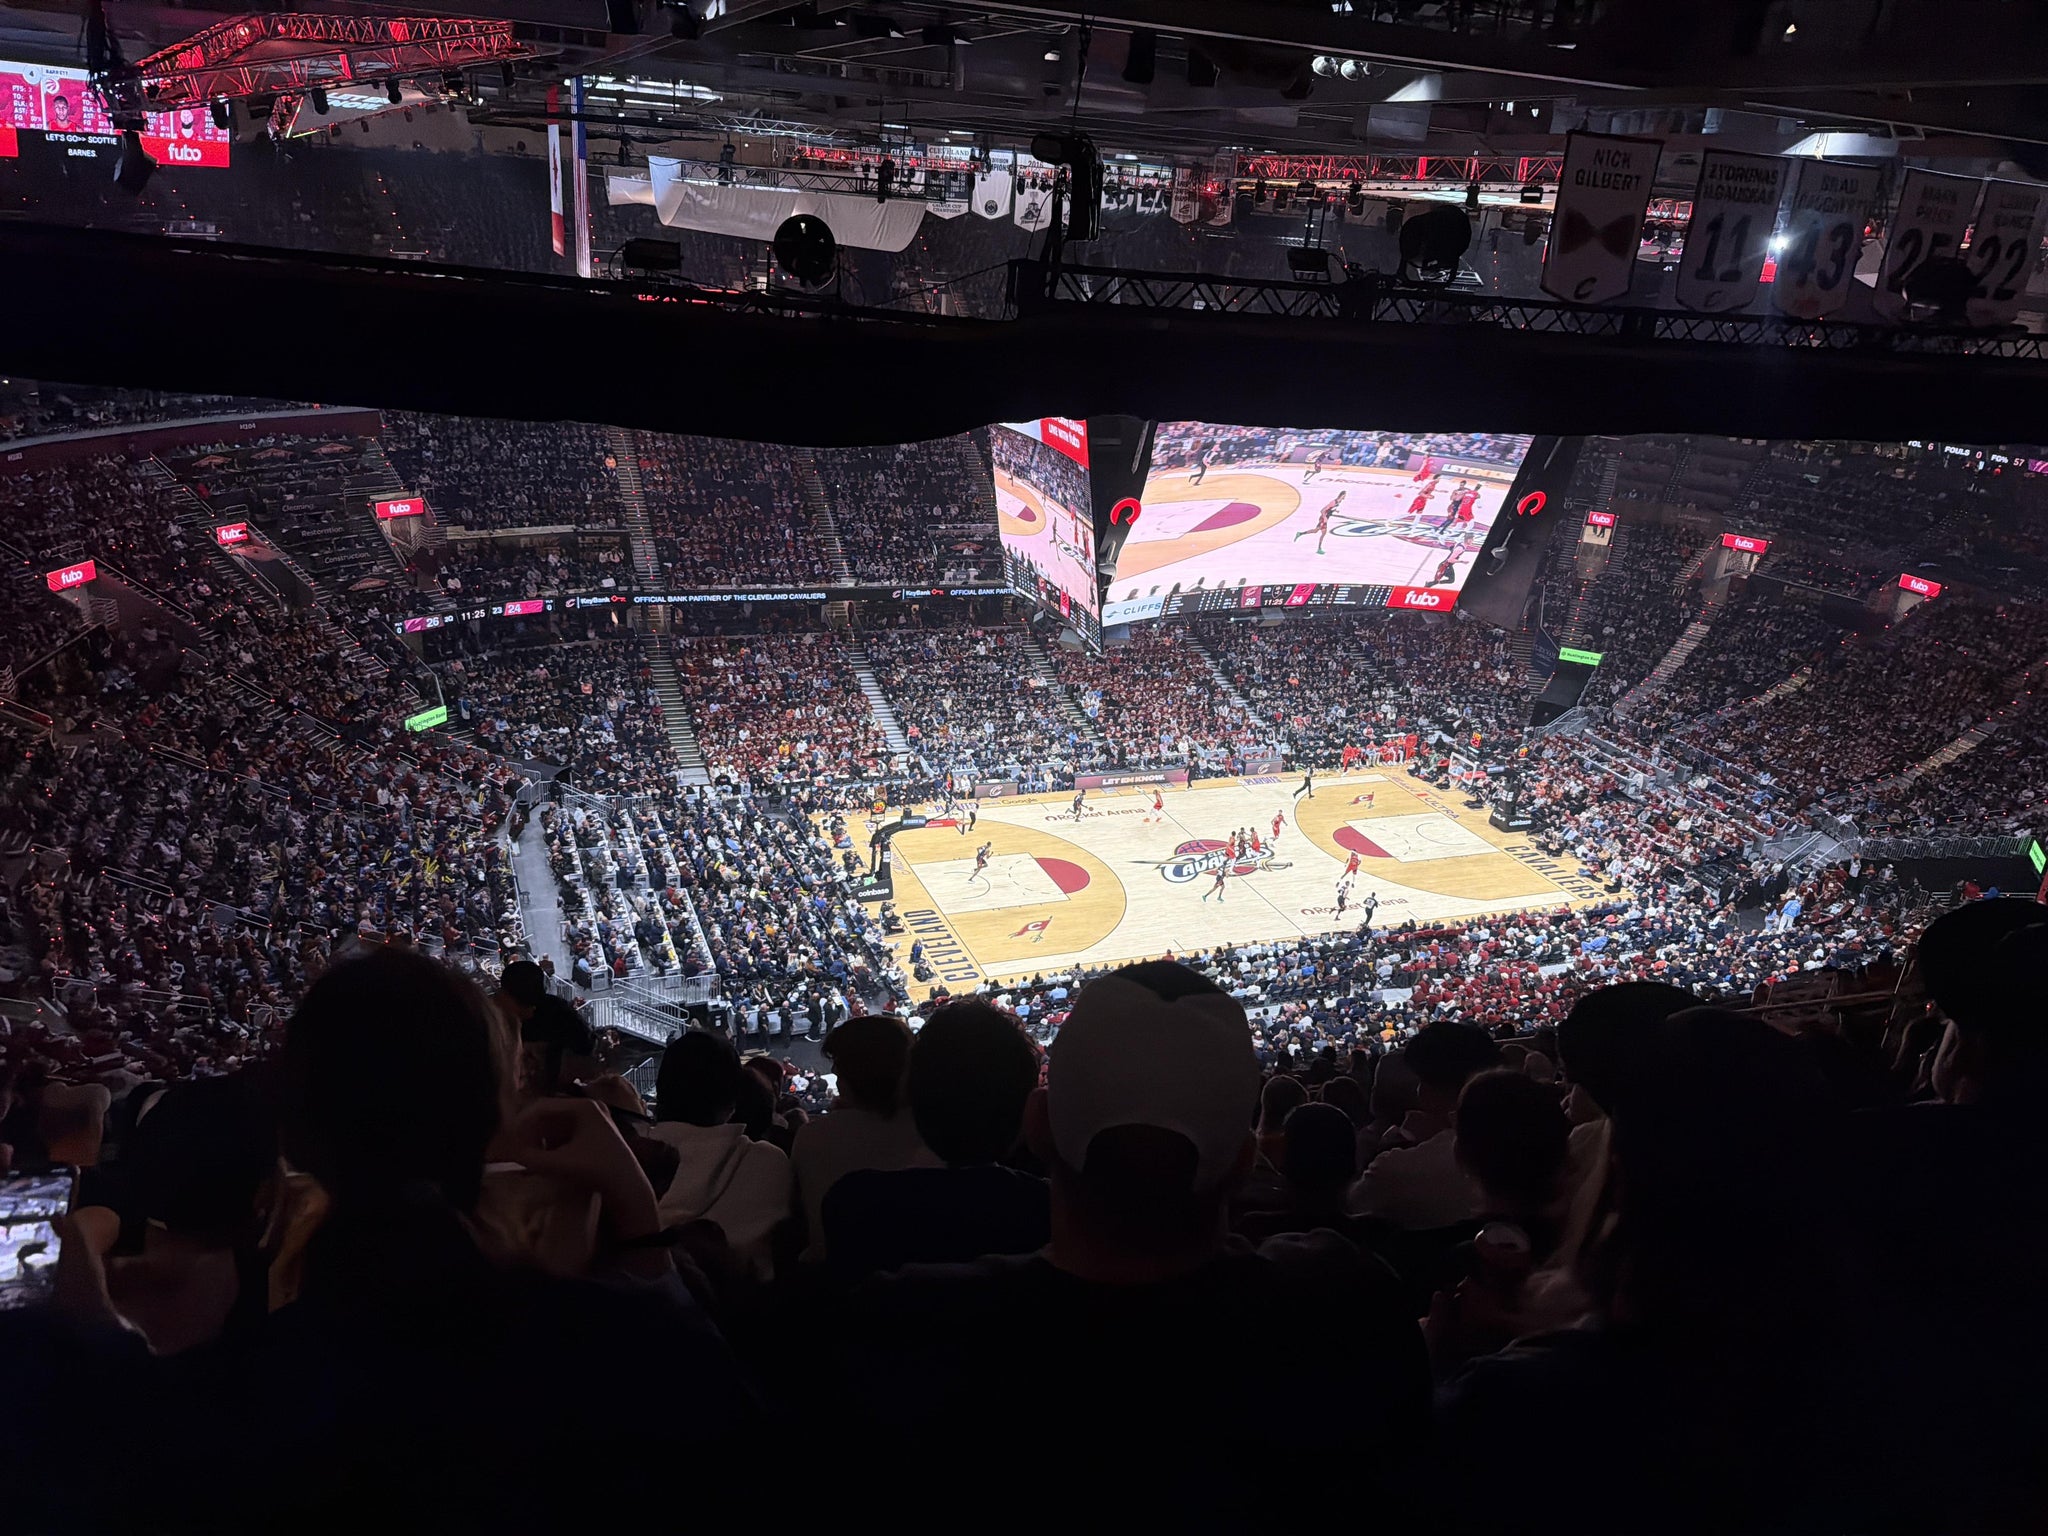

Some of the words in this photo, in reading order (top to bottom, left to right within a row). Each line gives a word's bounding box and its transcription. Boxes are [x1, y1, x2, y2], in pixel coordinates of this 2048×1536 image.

[45, 133, 65, 141] LET'S
[87, 136, 118, 145] SCOTTIE
[67, 148, 98, 158] BARNES.
[168, 143, 202, 161] fubo
[1593, 149, 1631, 168] NICK
[1575, 169, 1641, 191] GILBERT
[1695, 213, 1750, 282] 11
[1927, 442, 1934, 451] 6
[1944, 446, 1971, 456] FOULS
[1975, 451, 1983, 459] 0
[1991, 454, 2009, 464] FG%
[2013, 458, 2025, 467] 57
[282, 503, 314, 512] Cleaning
[388, 503, 411, 514] fubo
[1592, 514, 1610, 524] fubo
[301, 526, 344, 537] Restoration
[1734, 538, 1754, 548] fubo
[324, 551, 371, 564] Construction
[60, 569, 83, 584] fubo
[1910, 579, 1929, 592] fubo
[580, 596, 610, 605] KeyBank
[1245, 598, 1256, 606] 26
[1404, 591, 1440, 606] fubo
[1123, 602, 1161, 615] CLIFFS
[426, 617, 440, 628] 26
[461, 609, 486, 621] 11:25
[492, 606, 503, 615] 23
[507, 604, 522, 615] 24
[1121, 776, 1134, 784] EM
[1135, 774, 1165, 783] KNOW.
[1107, 808, 1146, 817] Arena
[1424, 798, 1460, 819] ULTRA
[1504, 845, 1605, 899] CAVALIERS
[858, 888, 890, 898] coinbase
[903, 909, 980, 982] CLEVELAND
